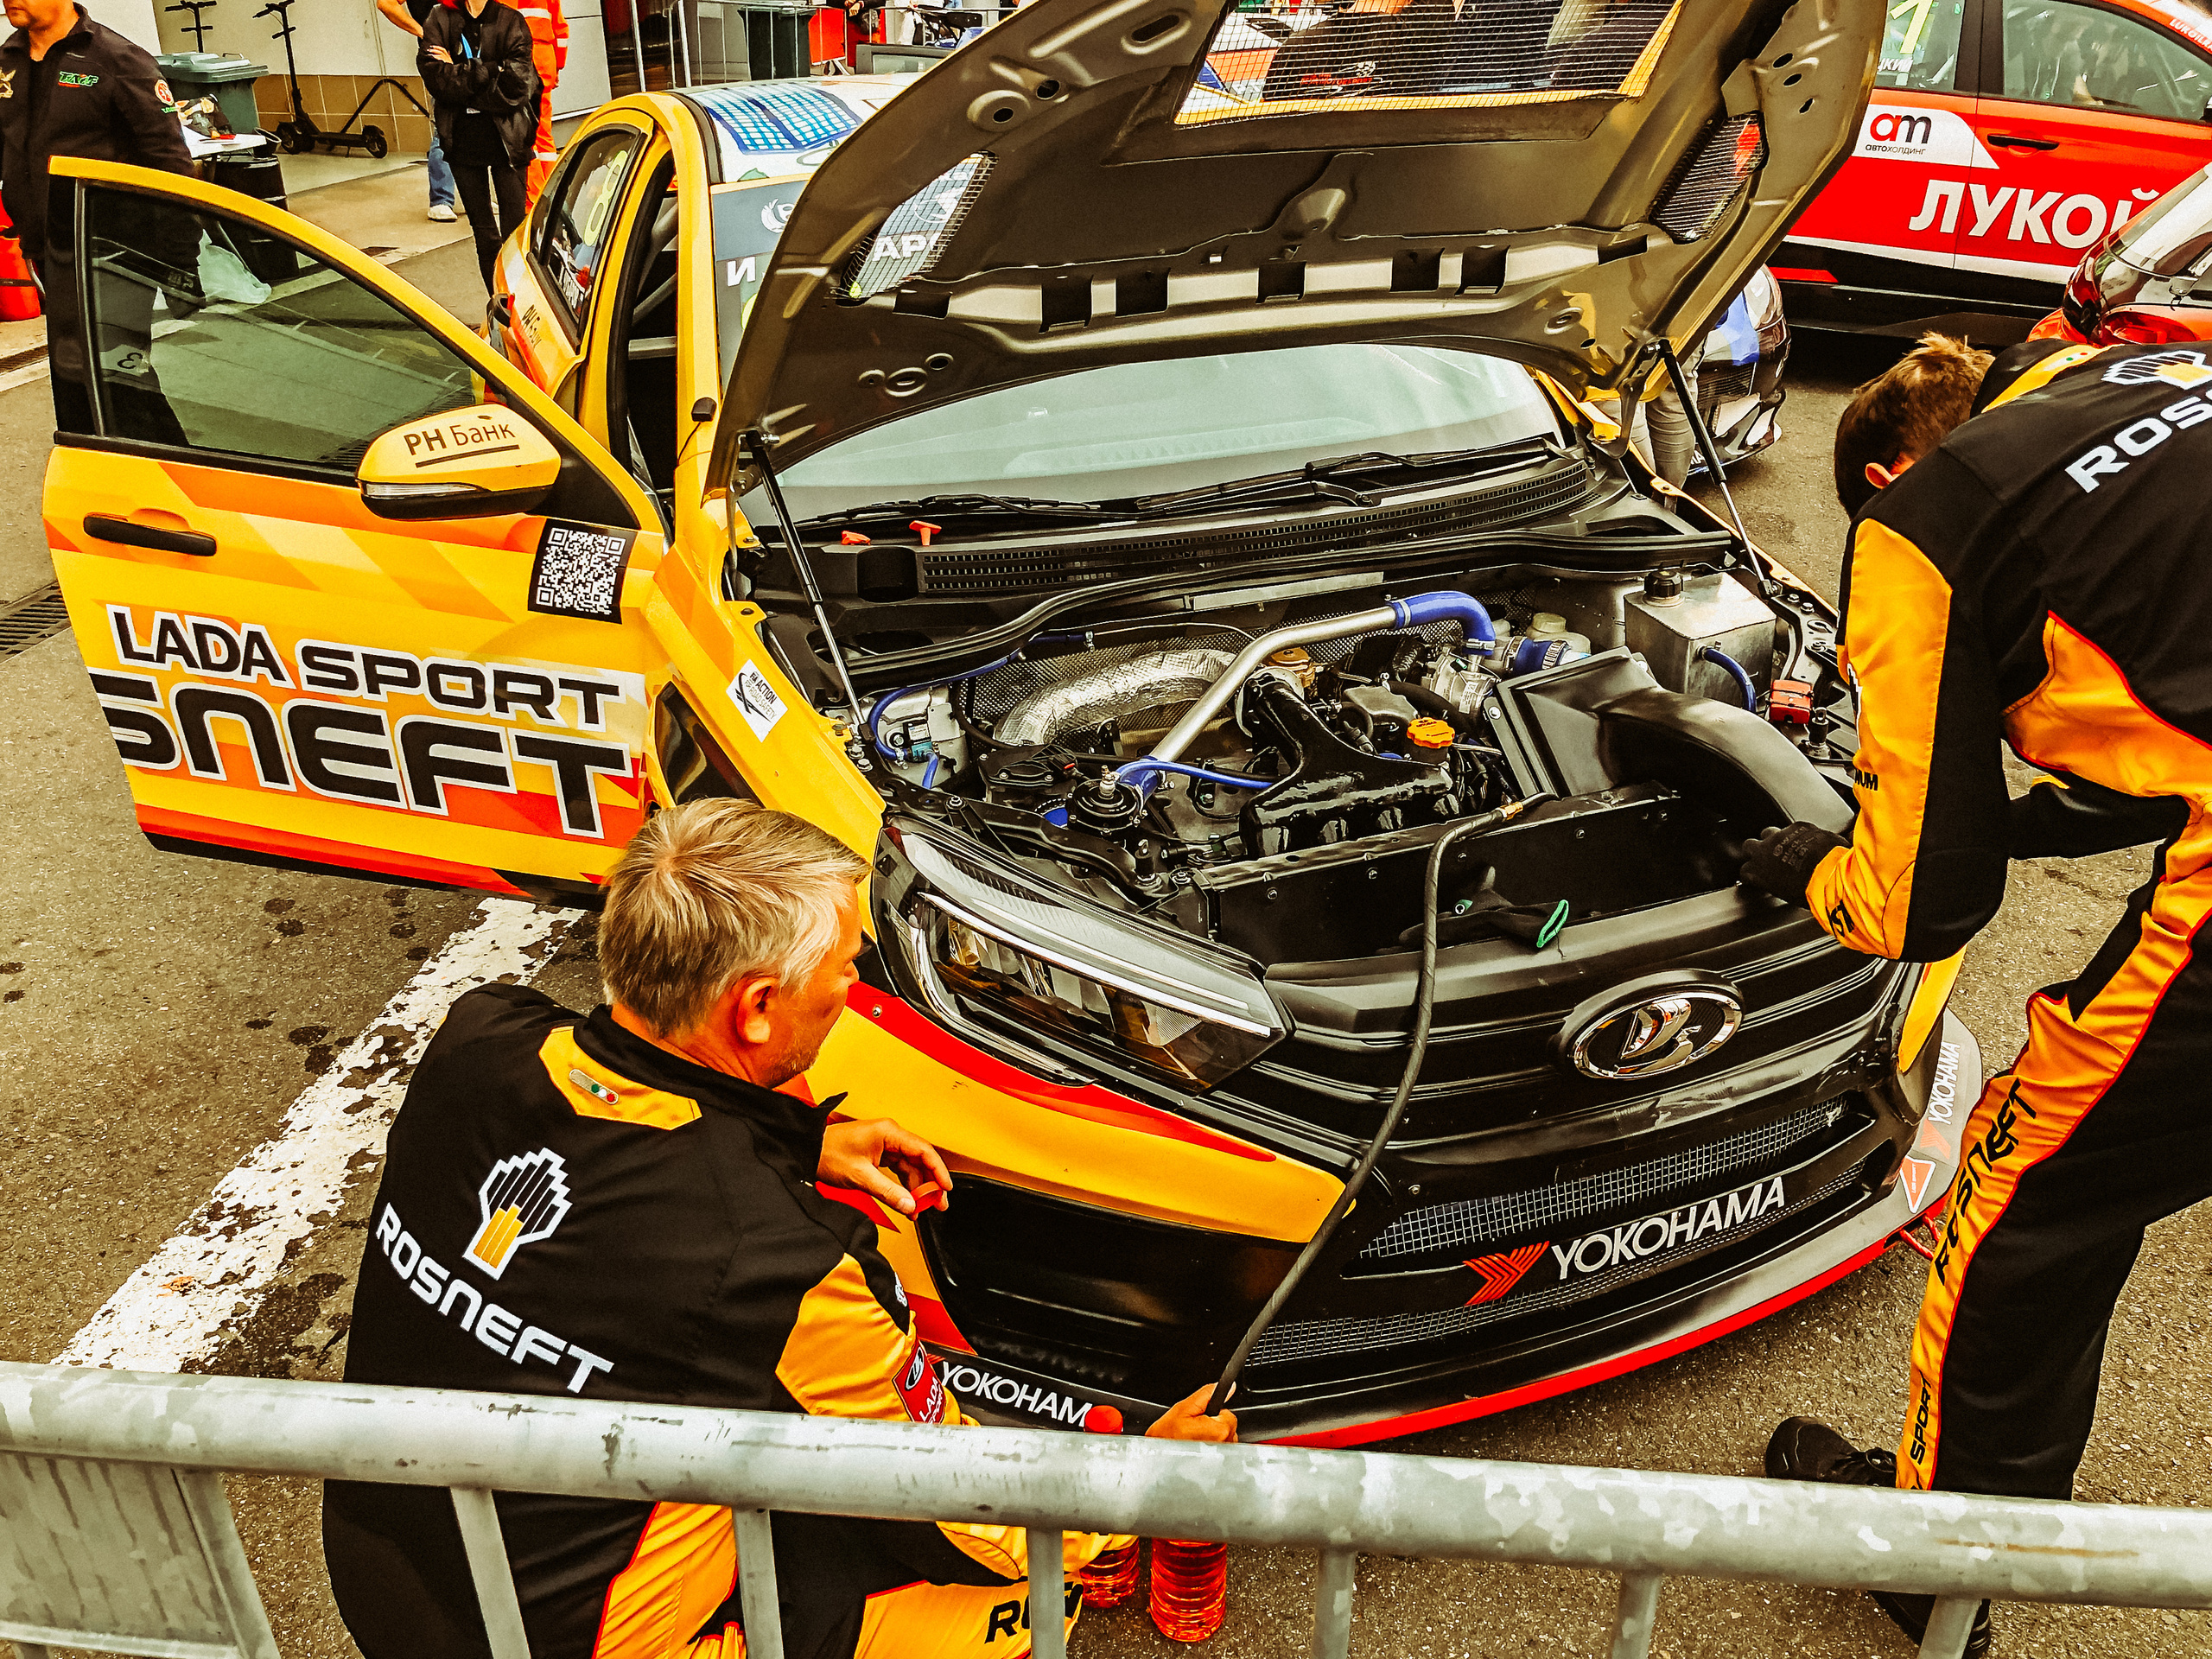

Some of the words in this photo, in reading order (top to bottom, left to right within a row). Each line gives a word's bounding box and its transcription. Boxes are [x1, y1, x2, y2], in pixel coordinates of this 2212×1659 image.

[1865, 144, 1927, 156] автохолдинг
[1870, 113, 1932, 144] am
[404, 428, 448, 455] РН
[449, 423, 516, 446] Банк
[2064, 390, 2212, 493] ROS
[109, 605, 293, 689] LADA
[296, 639, 624, 732] SPORT
[754, 679, 778, 705] ACTION
[748, 686, 763, 703] ROAD
[759, 699, 778, 720] SAFETY
[1928, 1040, 1961, 1125] YOKOHAMA
[1551, 1175, 1785, 1281] YOKOHAMA
[375, 1202, 615, 1394] ROSNEFT
[918, 1376, 939, 1422] LADA
[941, 1360, 1093, 1428] YOKOHAM
